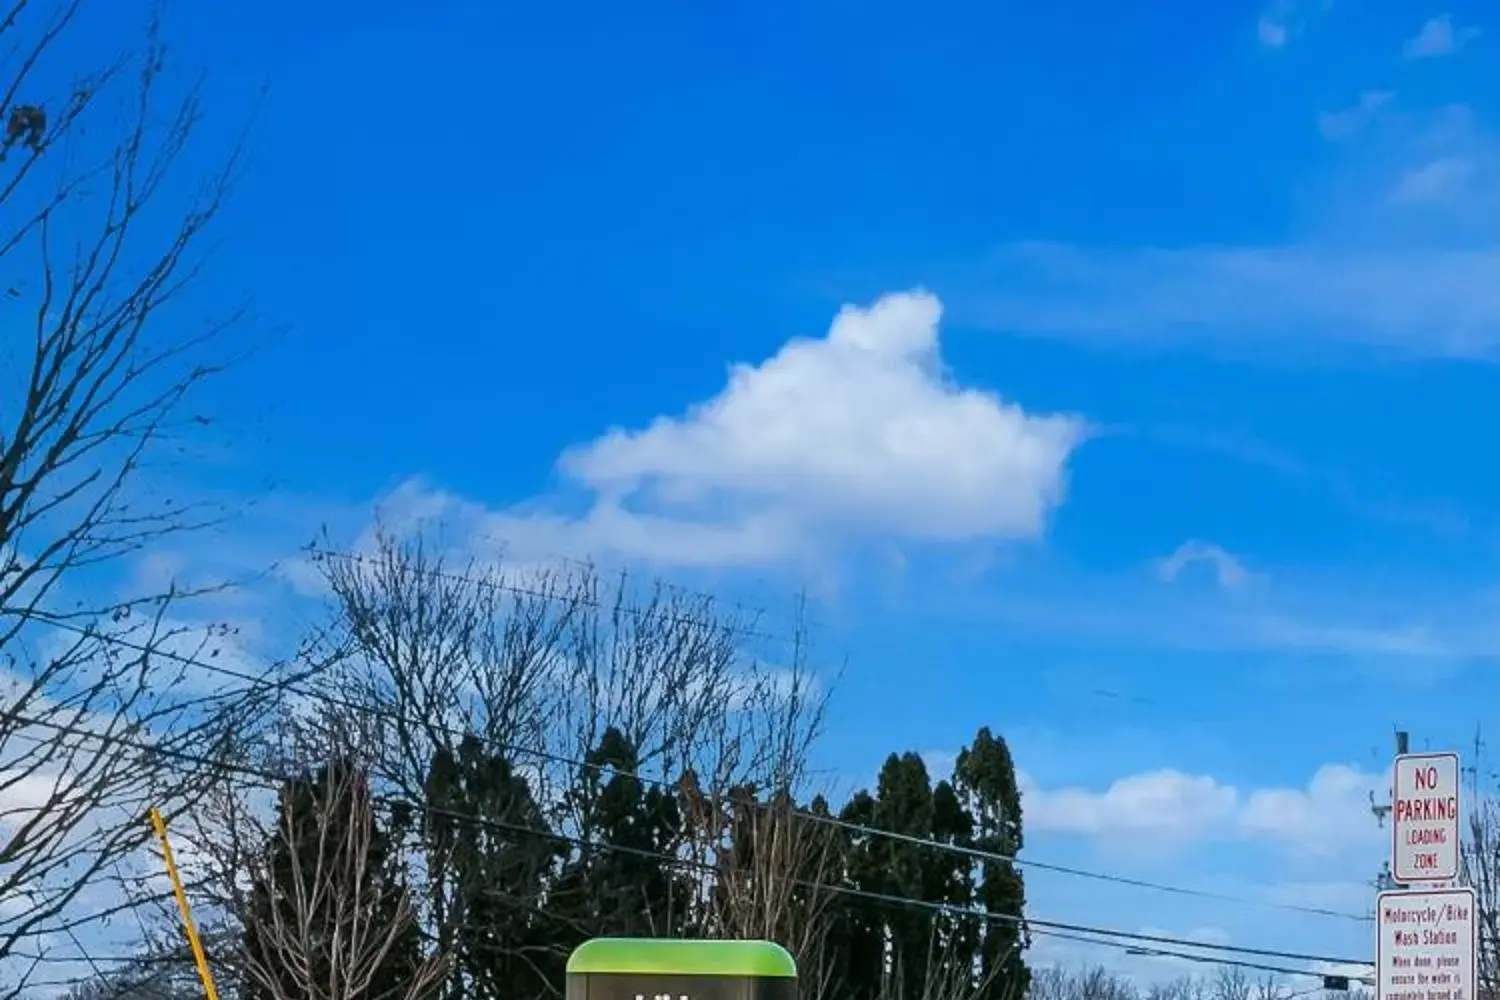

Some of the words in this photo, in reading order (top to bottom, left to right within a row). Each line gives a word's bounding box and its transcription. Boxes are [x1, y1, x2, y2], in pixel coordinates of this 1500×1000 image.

[1415, 767, 1437, 790] NO
[1397, 797, 1455, 822] PARKING
[1406, 828, 1447, 845] LOADING
[1414, 853, 1438, 869] ZONE
[1394, 930, 1419, 946] Wash
[1423, 929, 1457, 945] Station
